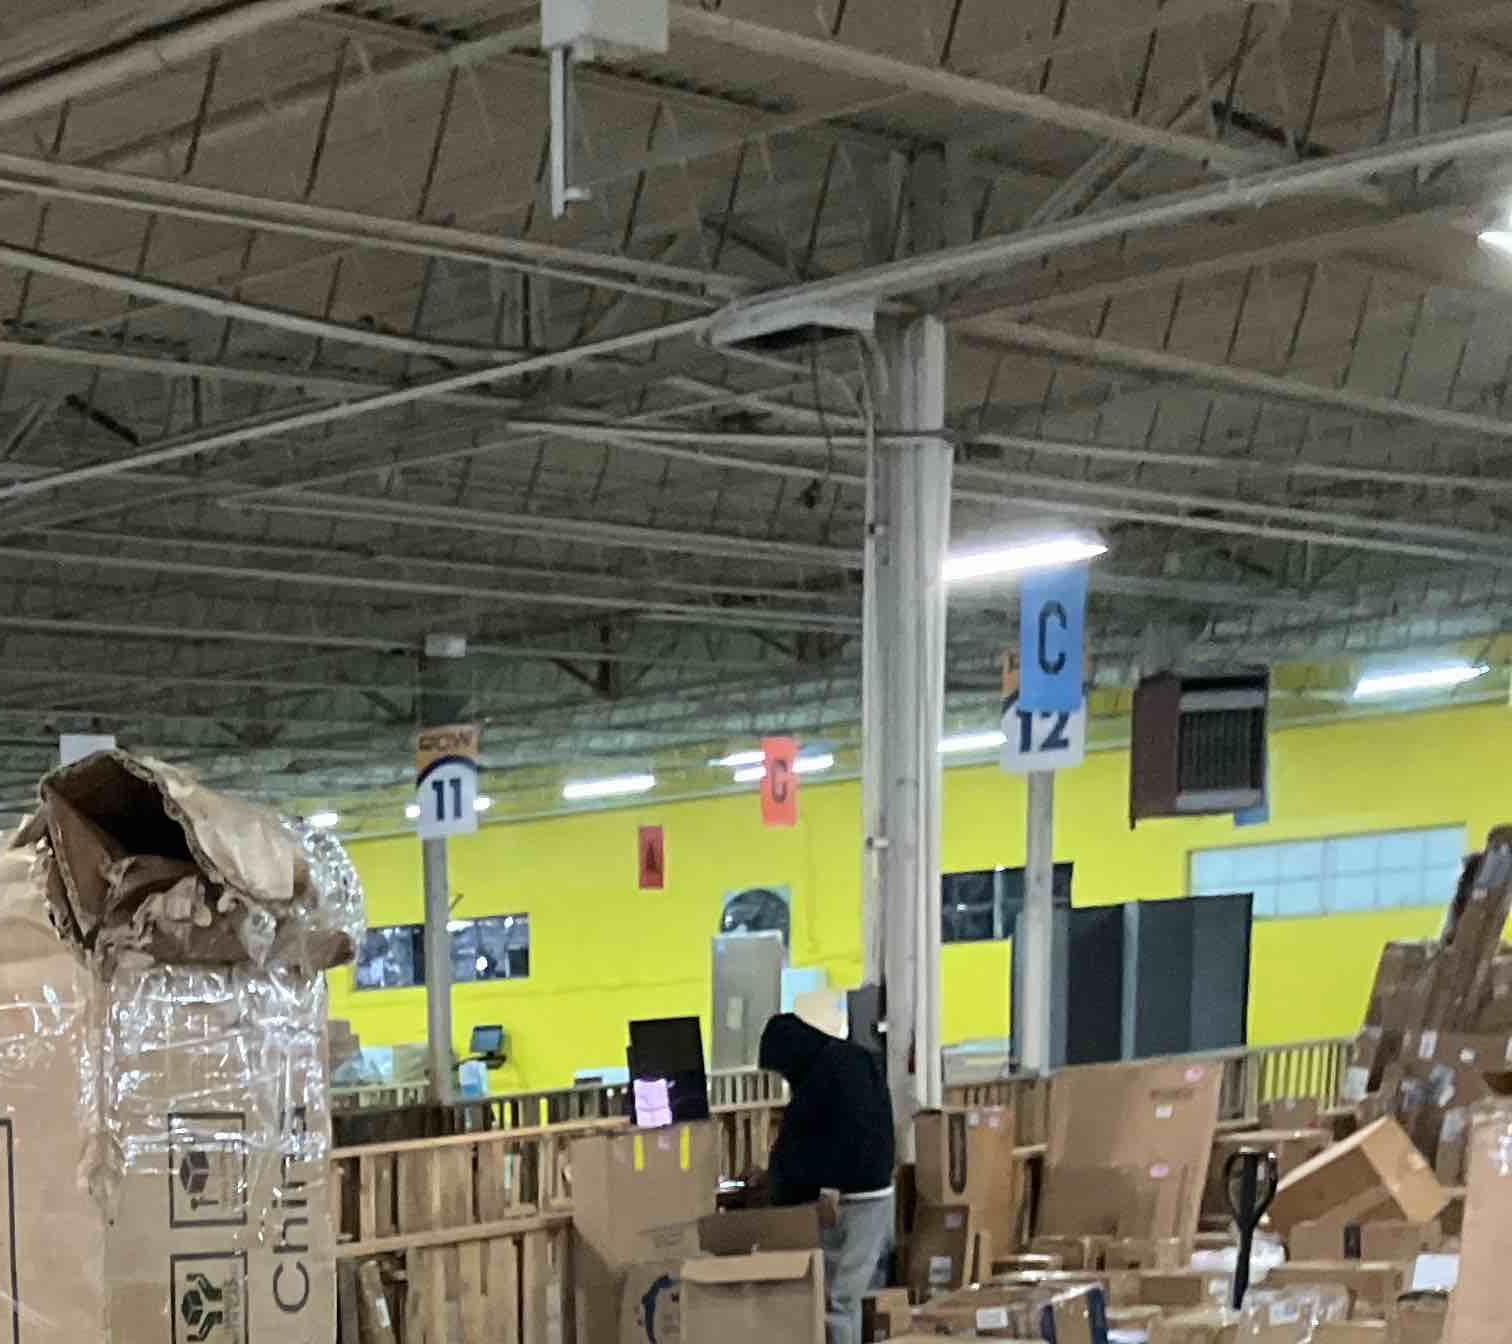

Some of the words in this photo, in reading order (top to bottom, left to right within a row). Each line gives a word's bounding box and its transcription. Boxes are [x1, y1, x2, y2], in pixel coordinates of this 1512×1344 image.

[1038, 600, 1067, 675] C
[1016, 710, 1070, 752] 12
[432, 777, 463, 820] 11
